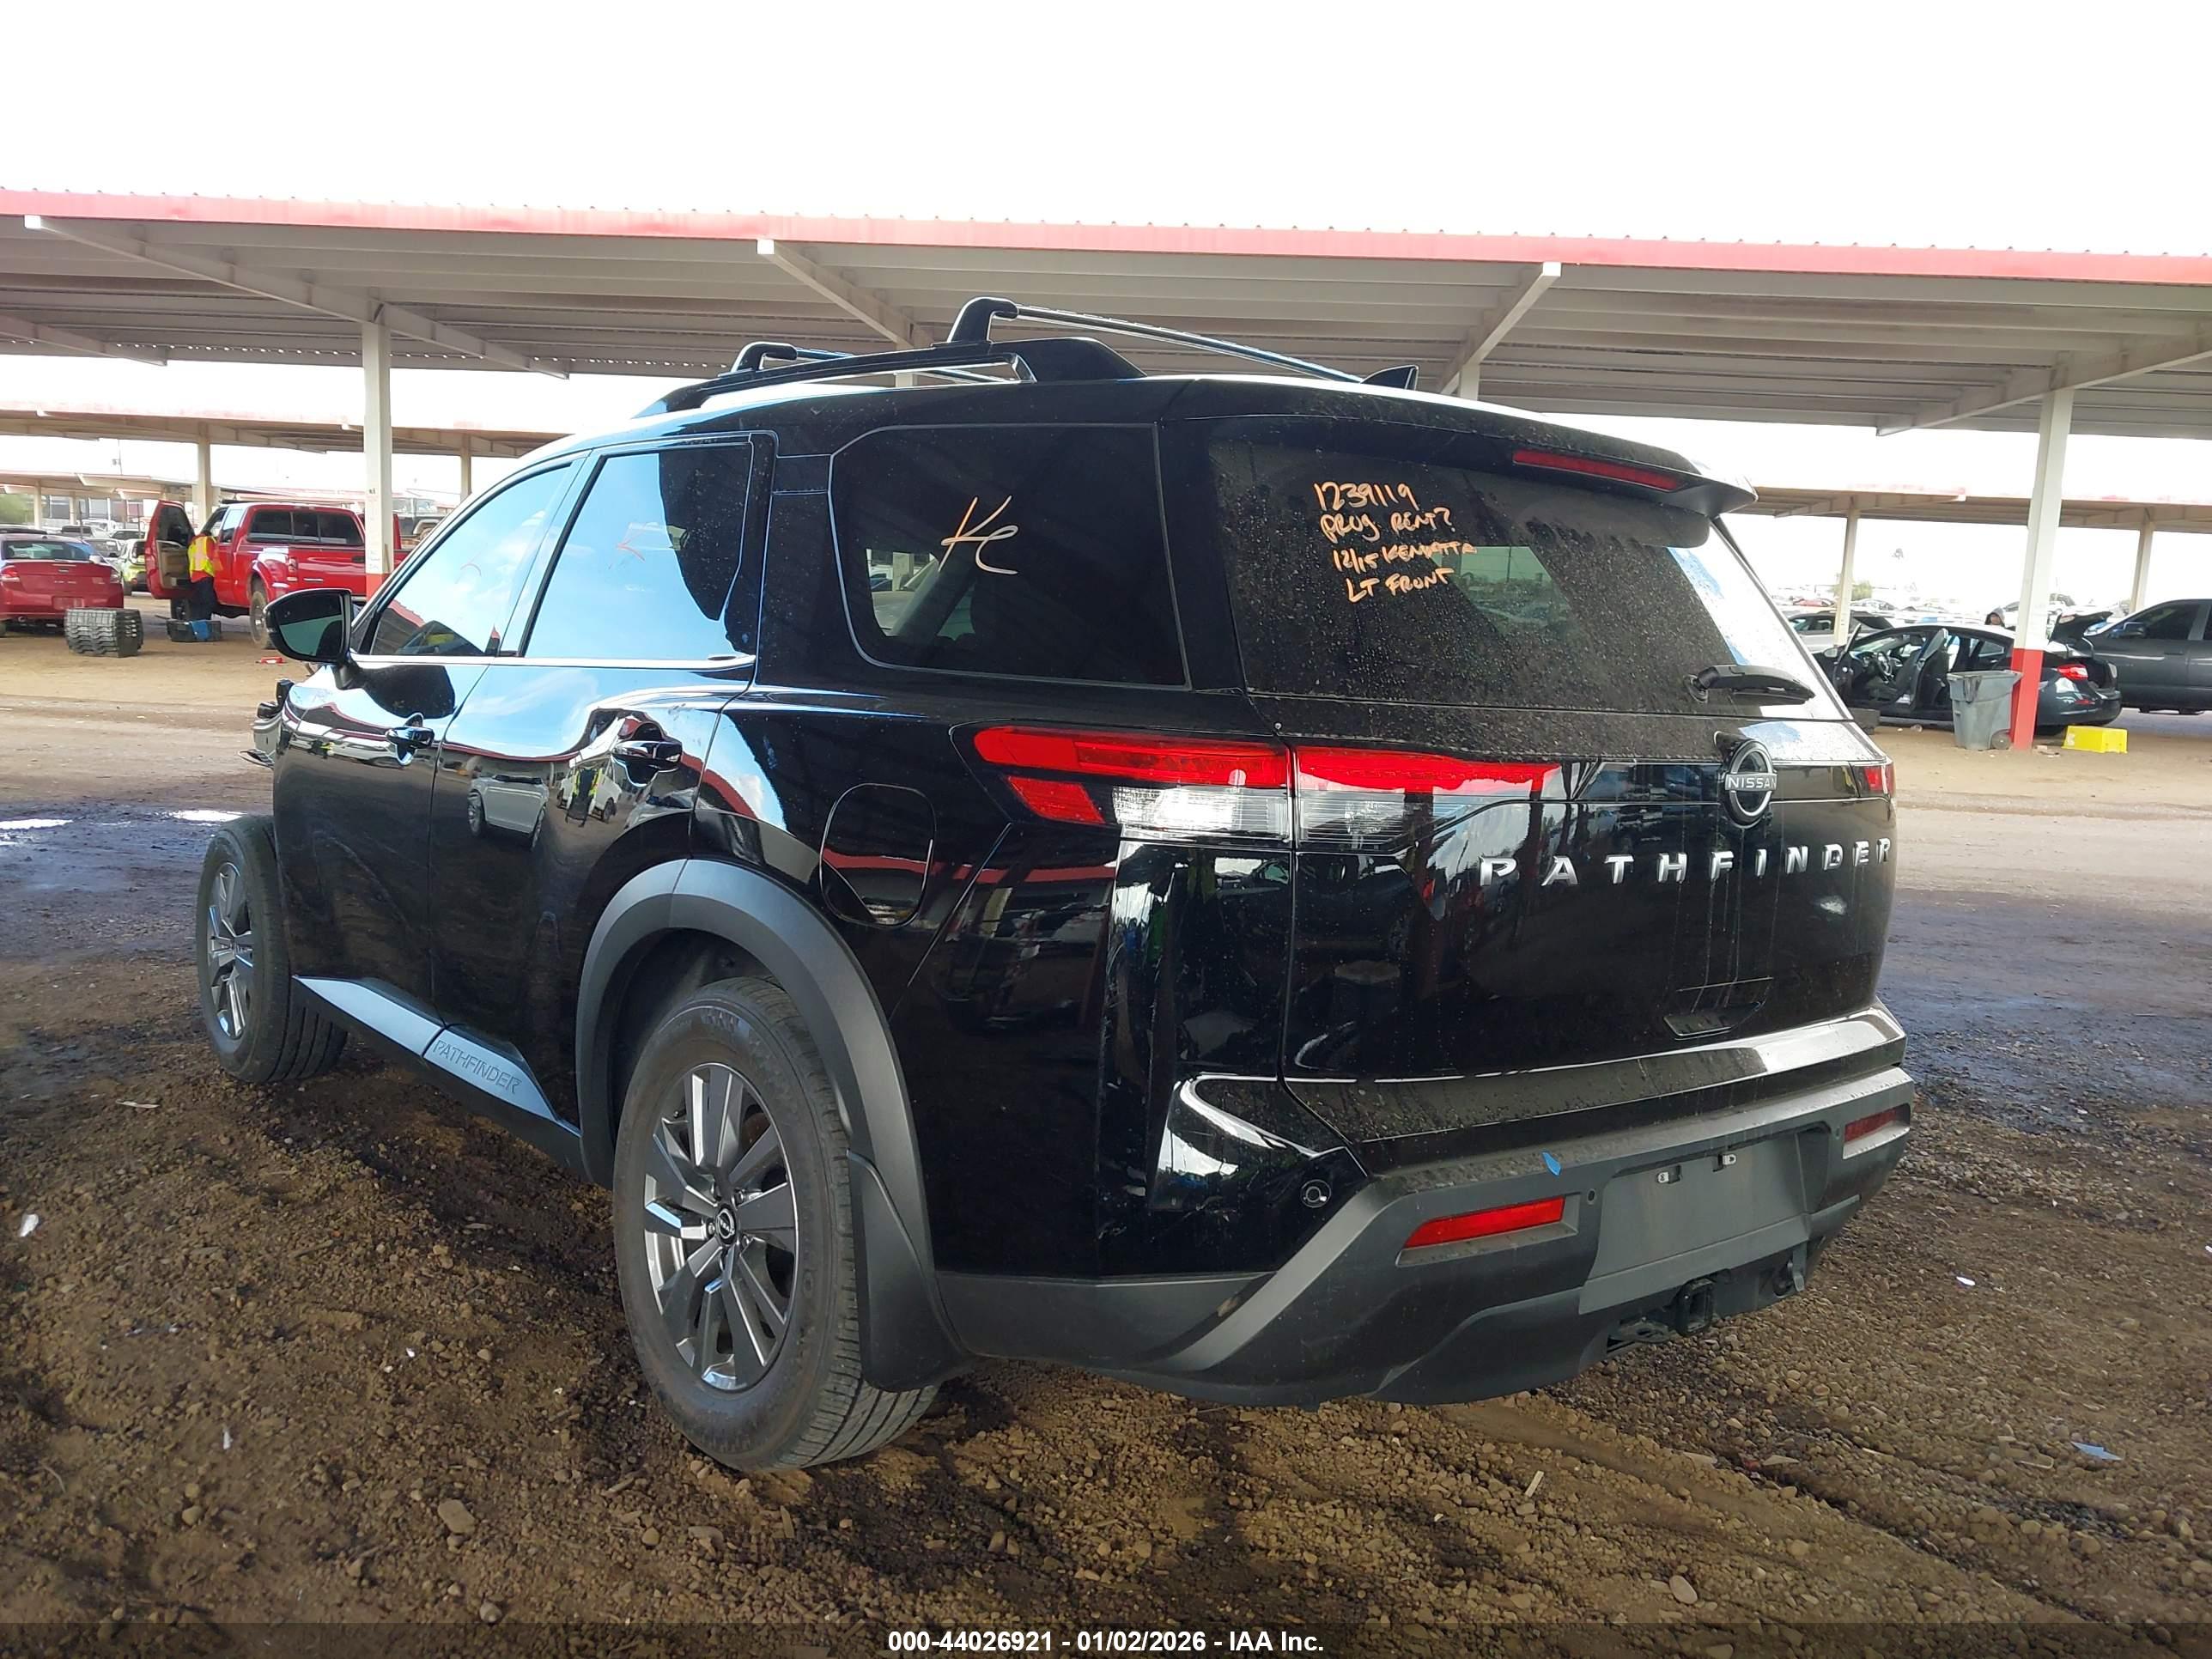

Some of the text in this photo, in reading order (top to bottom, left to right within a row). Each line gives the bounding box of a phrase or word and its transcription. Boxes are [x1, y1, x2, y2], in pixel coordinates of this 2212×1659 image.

[1346, 578, 1380, 602] LT
[1728, 776, 1777, 789] NISSAN
[1478, 837, 1891, 886] PATHFINDER
[432, 1039, 523, 1095] PATHFINDER
